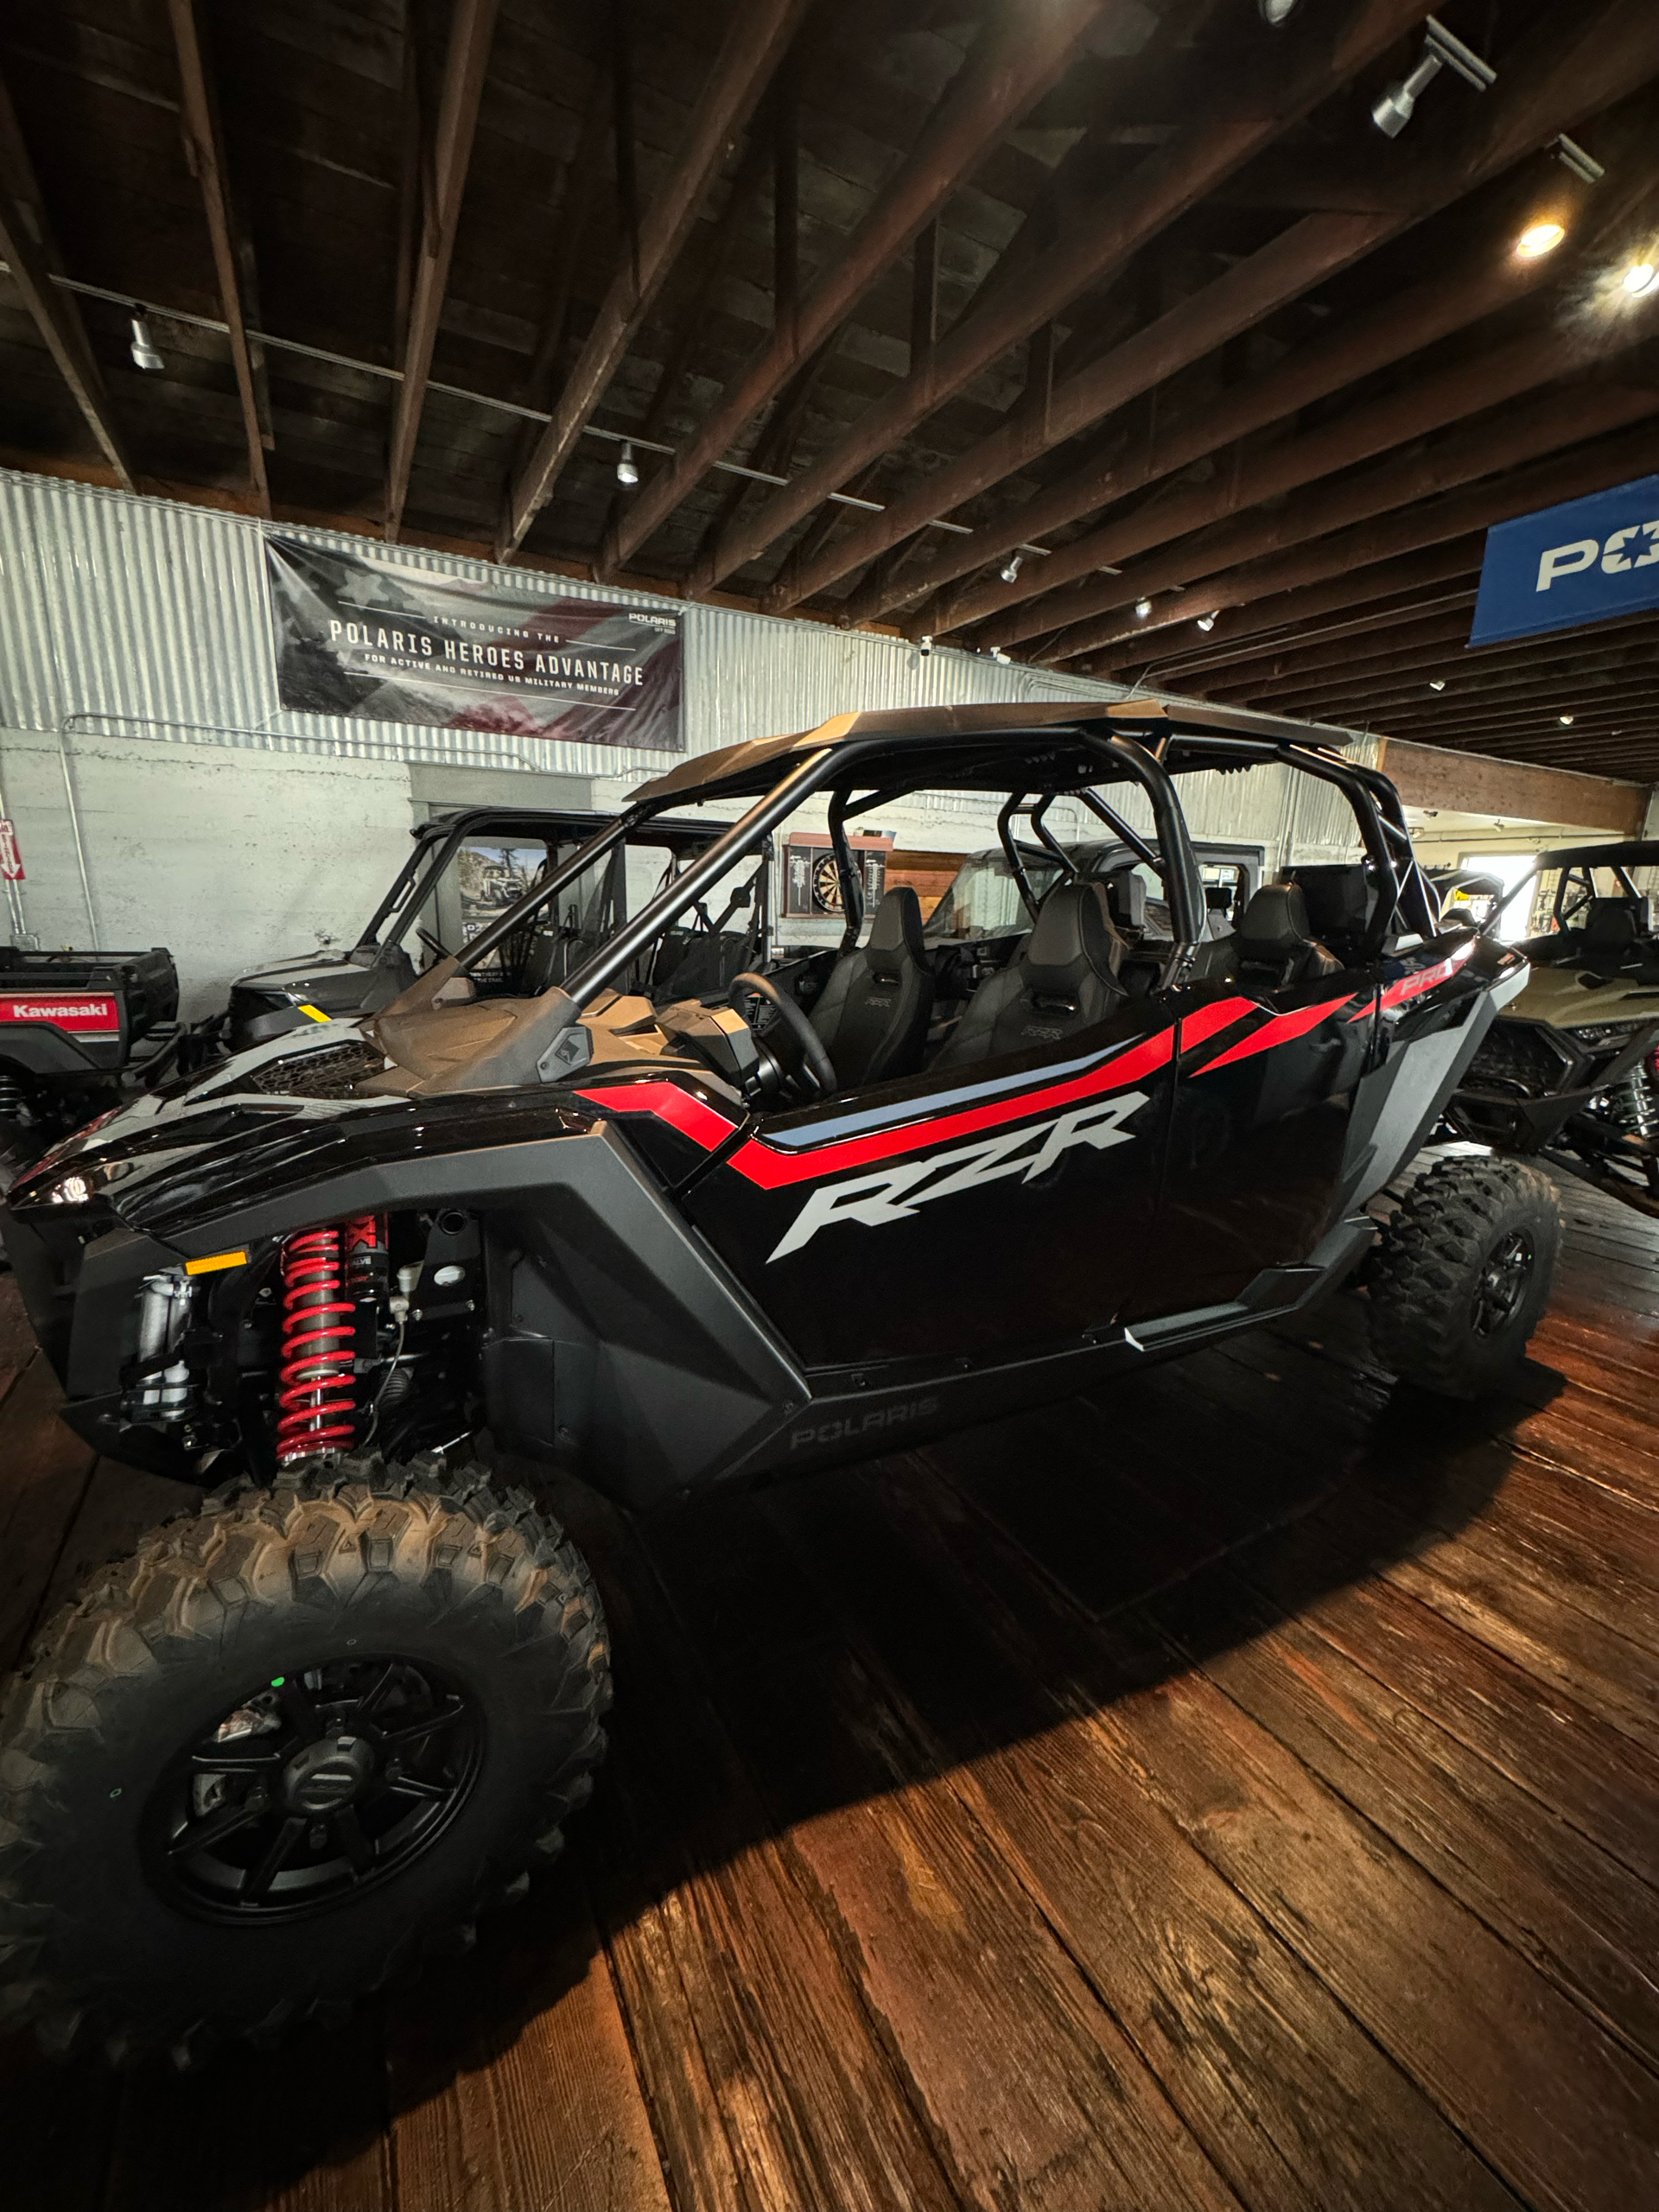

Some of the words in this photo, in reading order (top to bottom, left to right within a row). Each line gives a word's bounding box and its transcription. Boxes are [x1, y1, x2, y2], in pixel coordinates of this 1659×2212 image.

[433, 615, 529, 639] INTRODUCING
[537, 632, 560, 644] THE
[628, 613, 677, 627] POLARIS
[329, 619, 432, 657] POLARIS
[443, 639, 524, 671] HEROES
[535, 653, 644, 686] ADVANTAGE
[364, 653, 385, 664] FOR
[391, 657, 431, 671] ACTIVE
[435, 664, 456, 674] AND
[460, 668, 504, 681] RETIRED
[524, 677, 573, 690] MILITARY
[576, 682, 620, 696] MEMBERS
[13, 1003, 108, 1018] Kawasaki
[766, 1090, 1150, 1264] RZR
[790, 1396, 940, 1450] POLARIS
